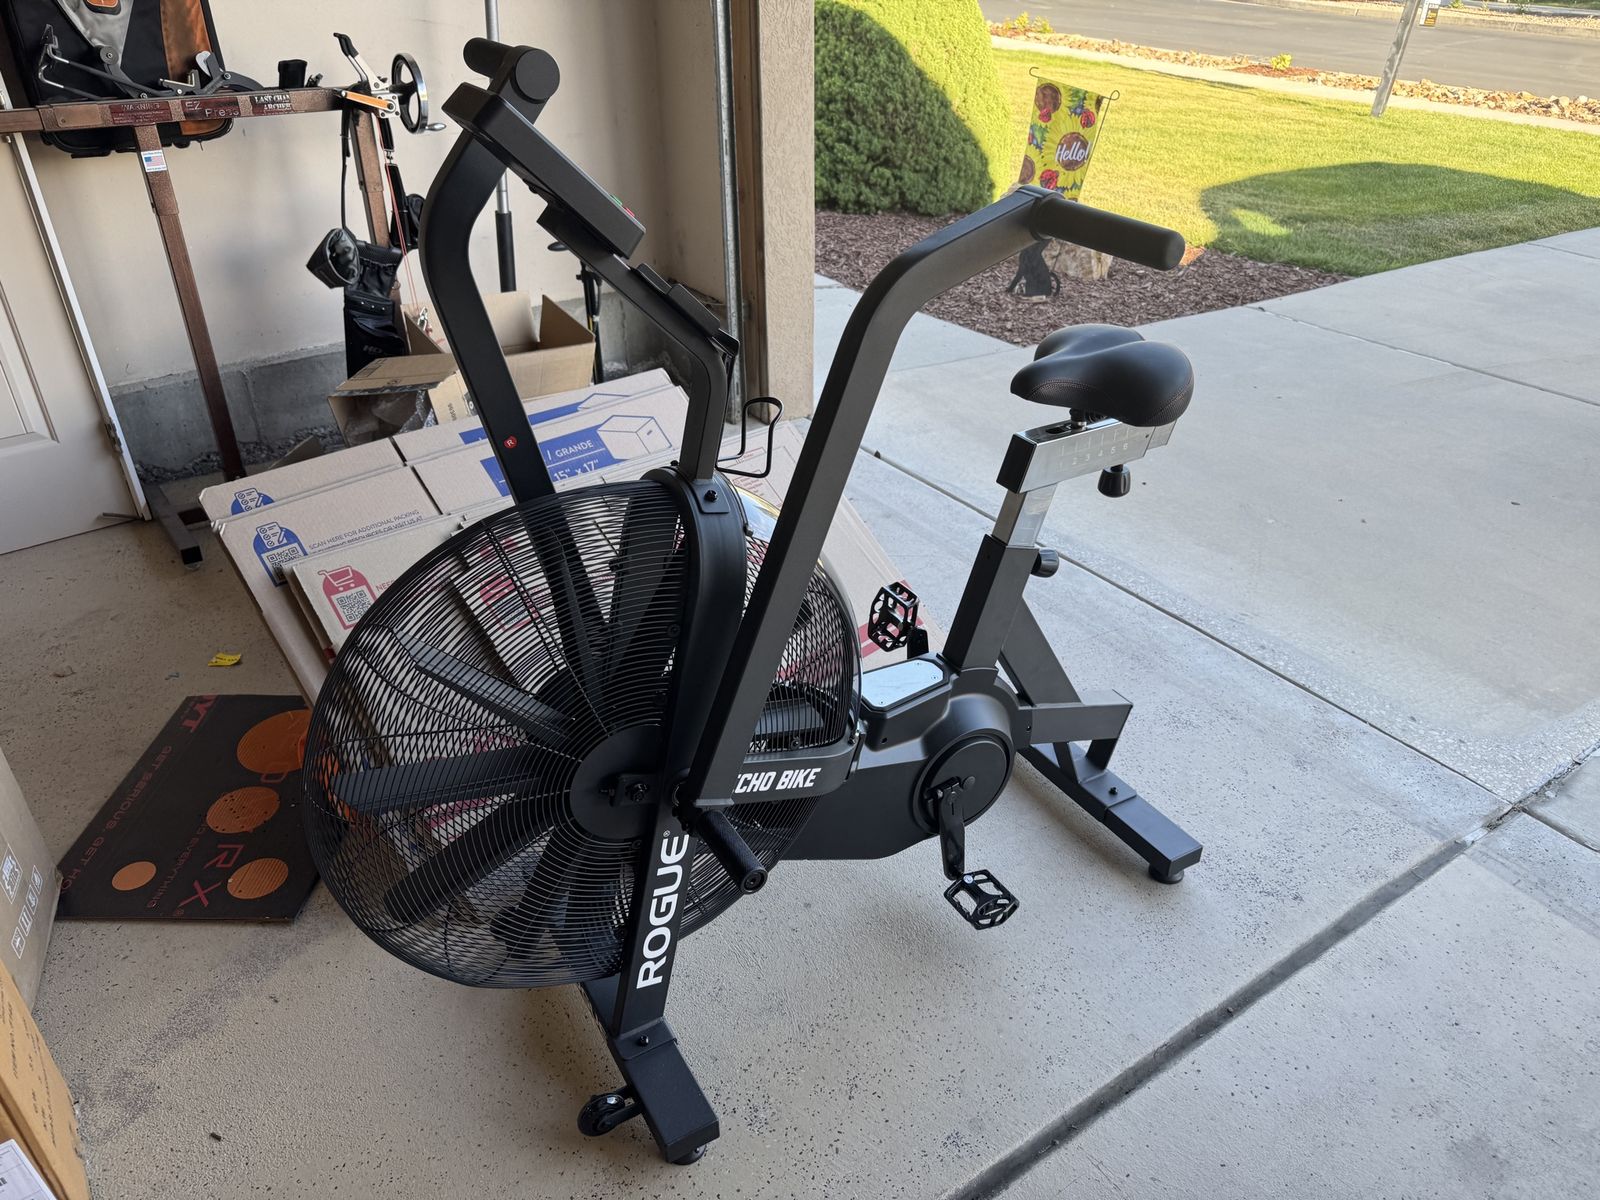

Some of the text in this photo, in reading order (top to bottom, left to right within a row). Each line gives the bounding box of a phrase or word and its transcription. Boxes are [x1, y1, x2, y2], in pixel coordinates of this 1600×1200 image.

[185, 101, 201, 110] EZ
[1055, 141, 1091, 163] Hello!
[555, 440, 594, 457] GRANDE
[309, 540, 327, 550] SCAN
[327, 534, 344, 543] HERE
[344, 529, 358, 538] FOR
[358, 519, 393, 534] ADDITIONAL
[376, 580, 394, 592] NEE
[734, 767, 822, 794] CHO BIKE
